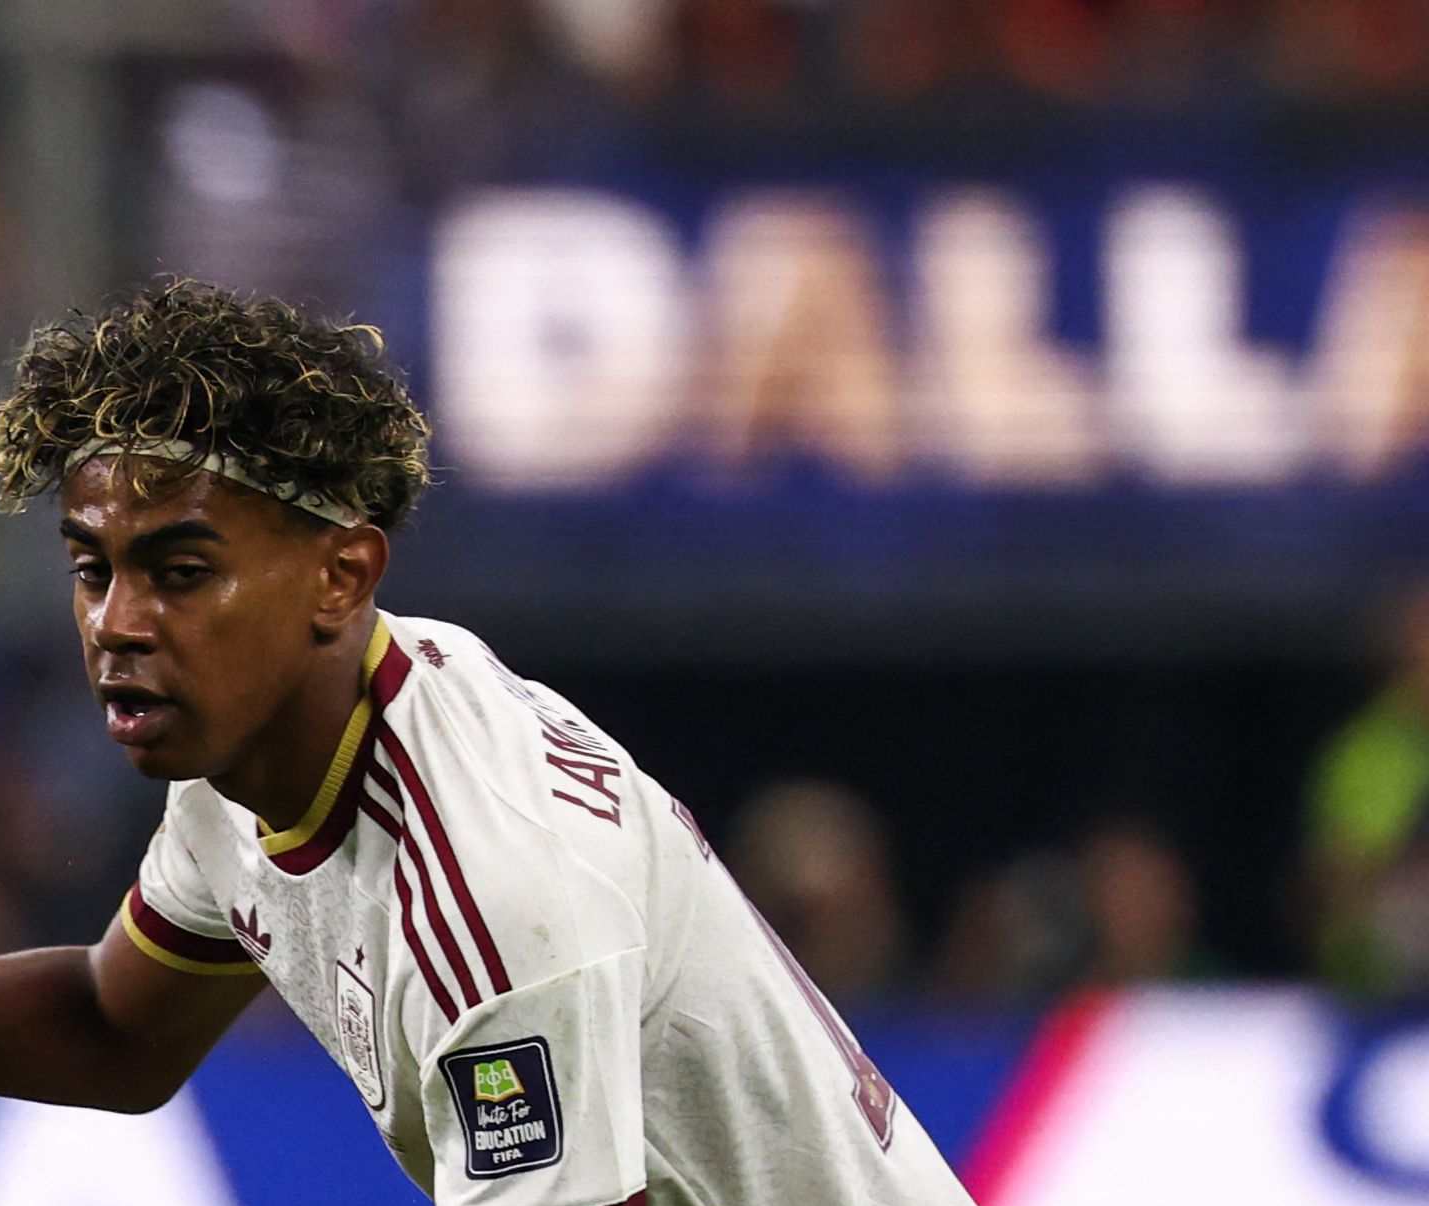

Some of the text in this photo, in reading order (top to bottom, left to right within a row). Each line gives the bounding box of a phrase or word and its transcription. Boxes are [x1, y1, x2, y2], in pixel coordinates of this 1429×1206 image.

[477, 1099, 531, 1127] Unite For
[474, 1120, 546, 1149] EDUCATION
[493, 1148, 523, 1163] FIFA
